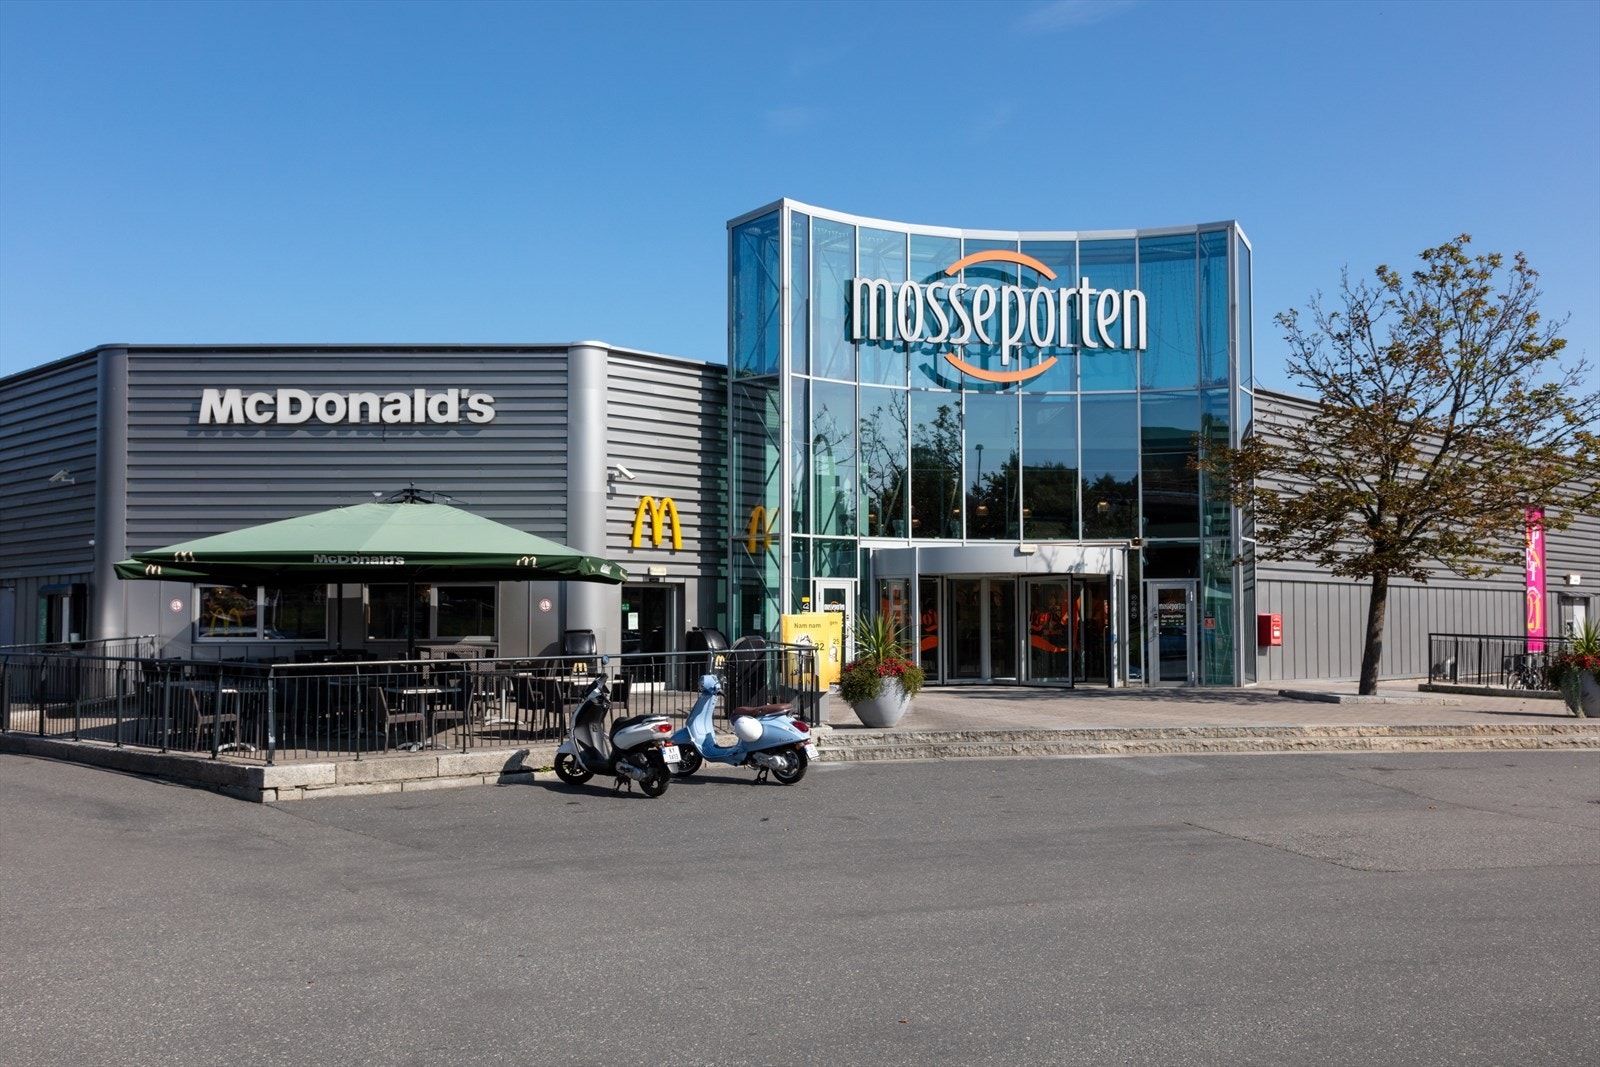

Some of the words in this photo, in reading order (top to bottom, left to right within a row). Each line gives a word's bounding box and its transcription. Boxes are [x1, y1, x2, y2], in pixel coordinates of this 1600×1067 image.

[853, 277, 1147, 366] mosseporten
[198, 388, 496, 424] McDonald's
[313, 554, 405, 565] McDonald's
